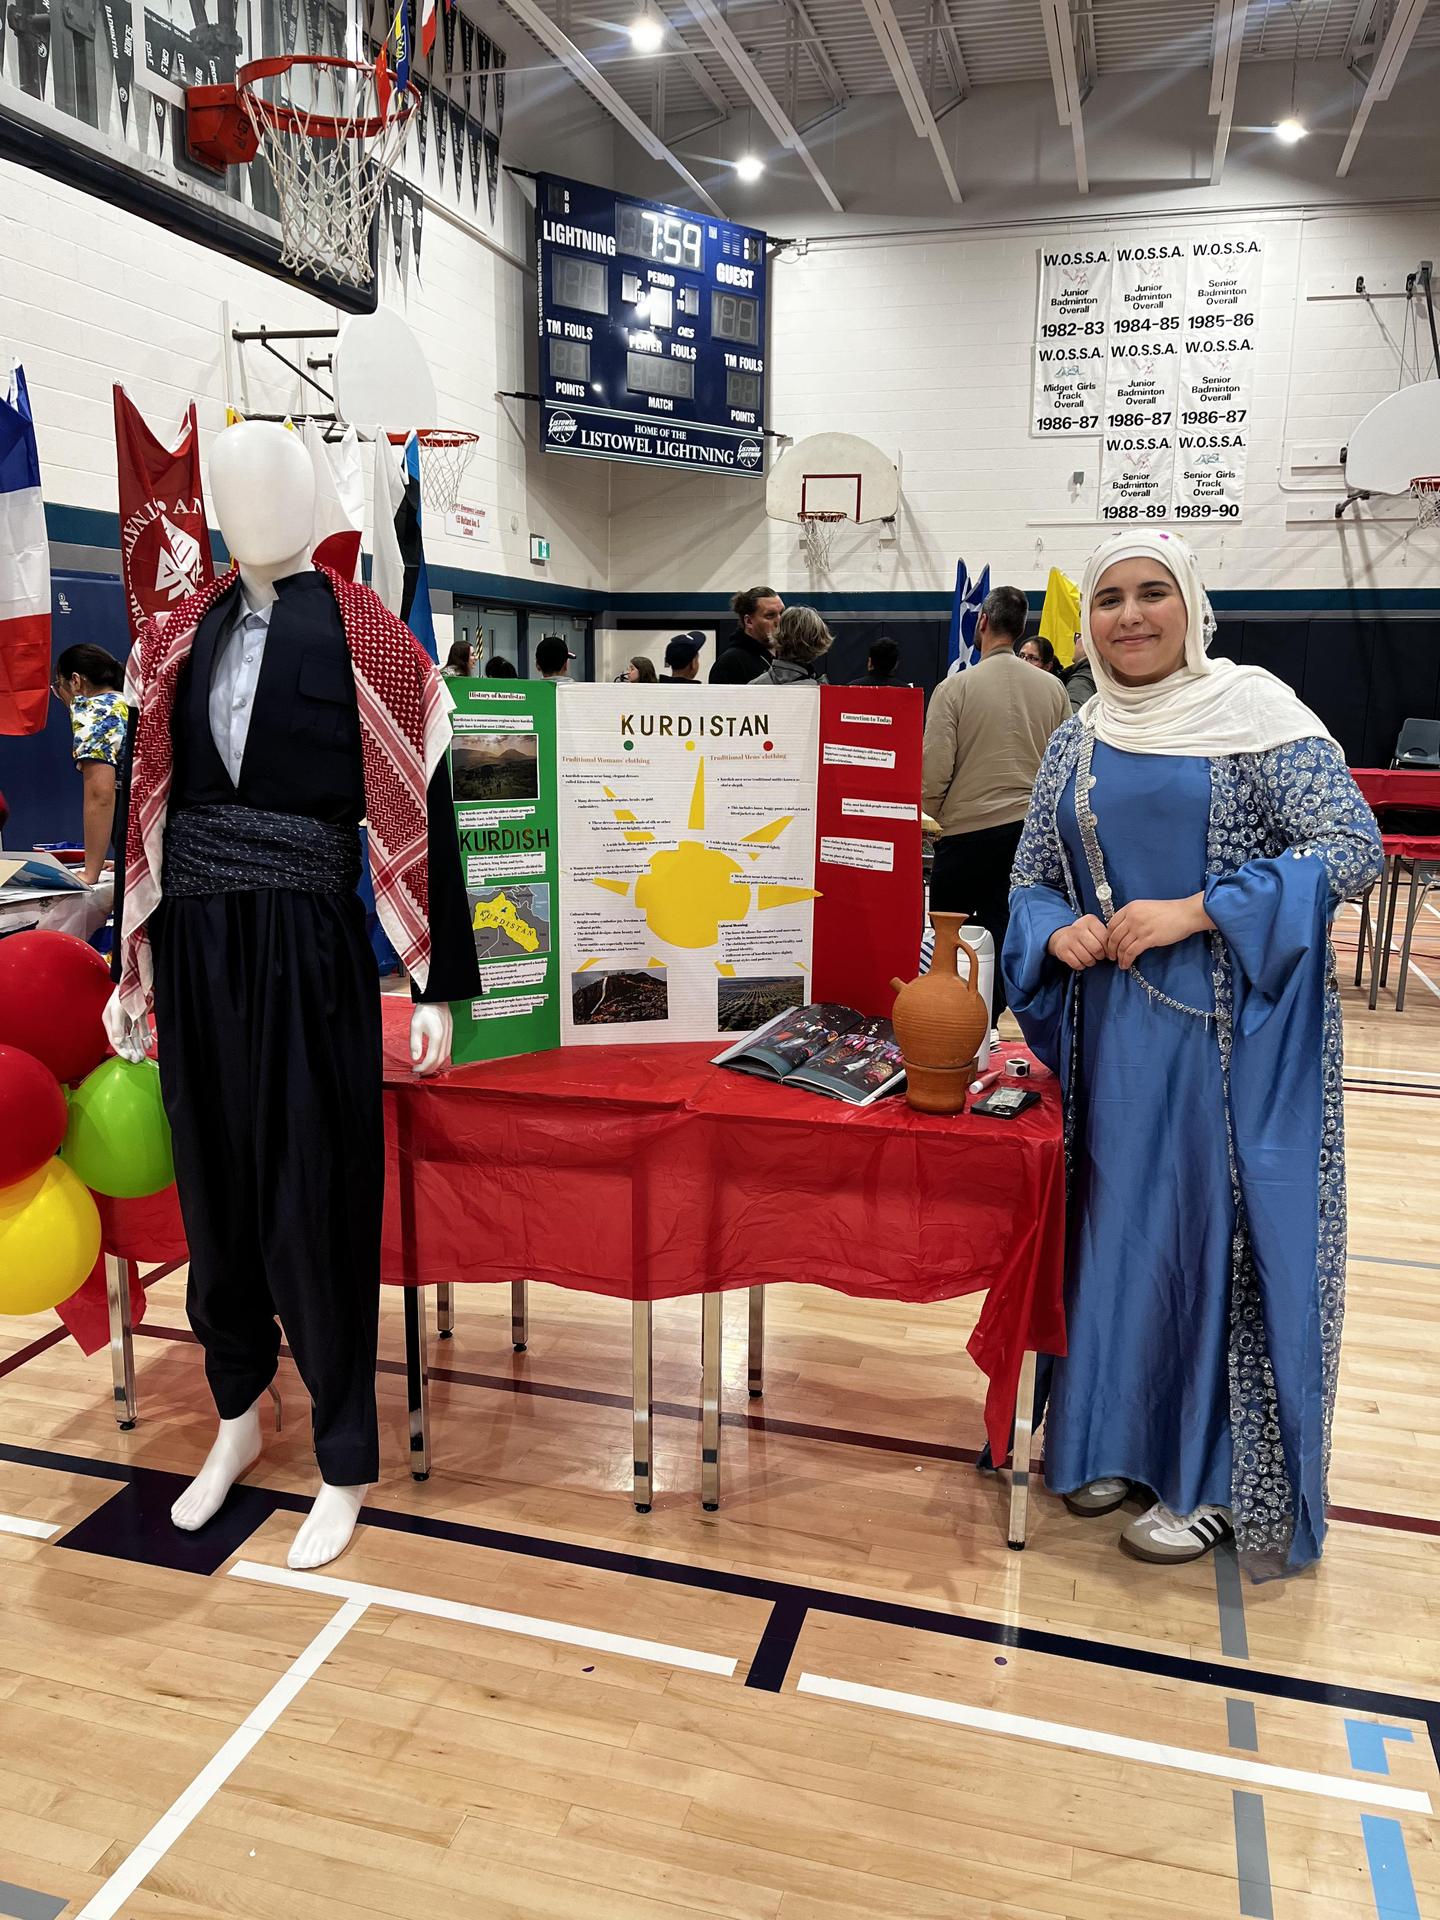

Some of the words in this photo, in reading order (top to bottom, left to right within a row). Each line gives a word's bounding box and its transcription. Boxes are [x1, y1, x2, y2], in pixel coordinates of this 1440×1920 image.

[105, 5, 119, 59] BADMINTON
[124, 24, 133, 57] SENIOR
[543, 220, 616, 256] LIGHTNING
[1117, 246, 1184, 262] W.O.S.S.A.
[1193, 241, 1261, 256] W.O.S.S.A.
[1044, 252, 1110, 267] W.O.S.S.A.
[648, 270, 675, 287] PERIOD
[716, 262, 754, 289] GUEST
[1208, 279, 1237, 288] Senior
[1124, 292, 1172, 302] Badminton
[1198, 287, 1247, 297] Badminton
[1051, 297, 1098, 306] Badminton
[1133, 301, 1163, 311] Overall
[1206, 297, 1238, 306] Overall
[1059, 306, 1089, 315] Overall
[1114, 316, 1180, 333] 1984-85
[1188, 313, 1254, 329] 1985-86
[547, 318, 561, 335] TM
[564, 322, 593, 340] FOULS
[1041, 321, 1104, 338] 1982-83
[671, 343, 697, 360] FOULS
[1111, 343, 1178, 358] W.O.S.S.A.
[1185, 339, 1254, 354] W.O.S.S.A.
[1039, 347, 1104, 362] W.O.S.S.A.
[724, 353, 737, 368] TM
[739, 356, 763, 372] FOULS
[556, 381, 585, 397] POINTS
[1043, 384, 1073, 392] Midget
[1077, 383, 1096, 391] Girls
[1128, 379, 1156, 387] Junior
[1191, 384, 1240, 394] Badminton
[1117, 388, 1165, 397] Badminton
[1200, 393, 1231, 402] Overall
[648, 397, 673, 411] MATCH
[1054, 400, 1084, 409] Overall
[1126, 396, 1156, 405] Overall
[731, 409, 755, 423] POINTS
[1036, 416, 1099, 431] 1986-87
[1108, 412, 1171, 427] 1986-87
[1181, 410, 1246, 424] 1986-87
[635, 425, 658, 436] HOME
[660, 428, 670, 438] OF
[671, 430, 686, 440] THE
[581, 430, 652, 454] LISTOWEL
[656, 440, 734, 464] LIGHTNING
[1107, 437, 1172, 450] W.O.S.S.A.
[1179, 435, 1246, 449] W.O.S.S.A.
[1113, 481, 1158, 489] Badminton
[1193, 488, 1224, 496] Overall
[1120, 489, 1150, 497] Overall
[1102, 505, 1166, 518] 1988-89
[1174, 504, 1239, 518] 1989-90
[621, 714, 768, 737] KURDISTAN
[460, 828, 550, 852] KURDISH
[480, 910, 534, 936] KURDISTAN
